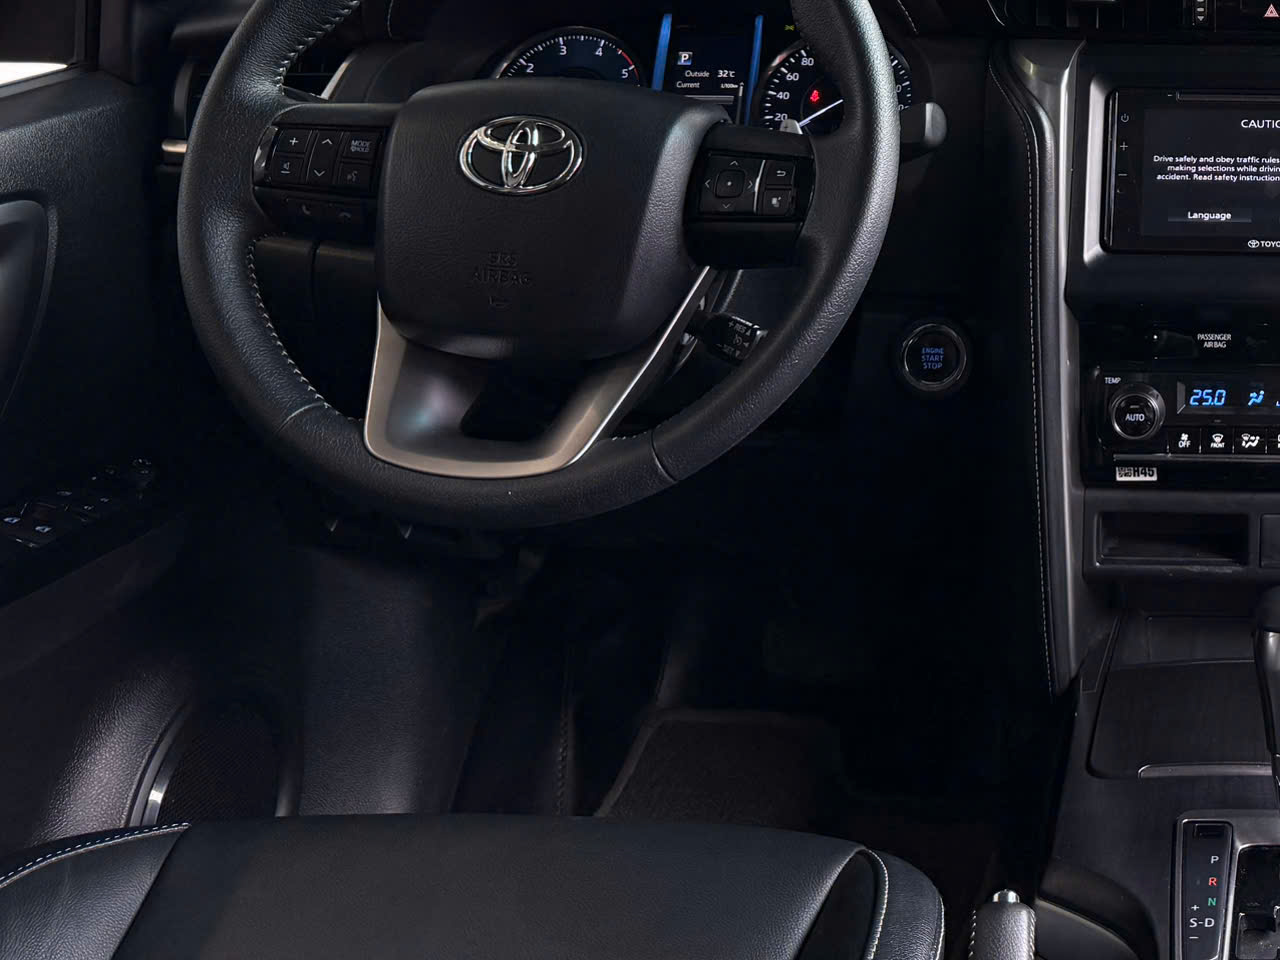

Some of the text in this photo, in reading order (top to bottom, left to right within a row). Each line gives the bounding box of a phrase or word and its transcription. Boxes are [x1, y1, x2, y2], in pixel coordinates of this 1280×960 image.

[559, 46, 567, 56] 3
[595, 47, 603, 57] 4
[801, 57, 815, 67] 80
[526, 63, 535, 73] 2
[621, 68, 629, 78] 5
[684, 70, 710, 78] Outside
[786, 72, 800, 82] 60
[676, 81, 700, 89] Current
[776, 91, 790, 100] 40
[774, 113, 788, 121] 20
[1175, 155, 1198, 164] safely
[1215, 156, 1235, 165] obey
[1167, 165, 1197, 173] making
[1193, 173, 1213, 181] Read
[1214, 174, 1238, 183] safety
[1239, 174, 1280, 182] instruction
[1187, 211, 1232, 221] Language
[1197, 333, 1232, 341] PASSENGER
[1189, 389, 1226, 405] 25.0
[1210, 855, 1219, 864] P
[1208, 877, 1218, 887] R
[1208, 897, 1217, 906] N
